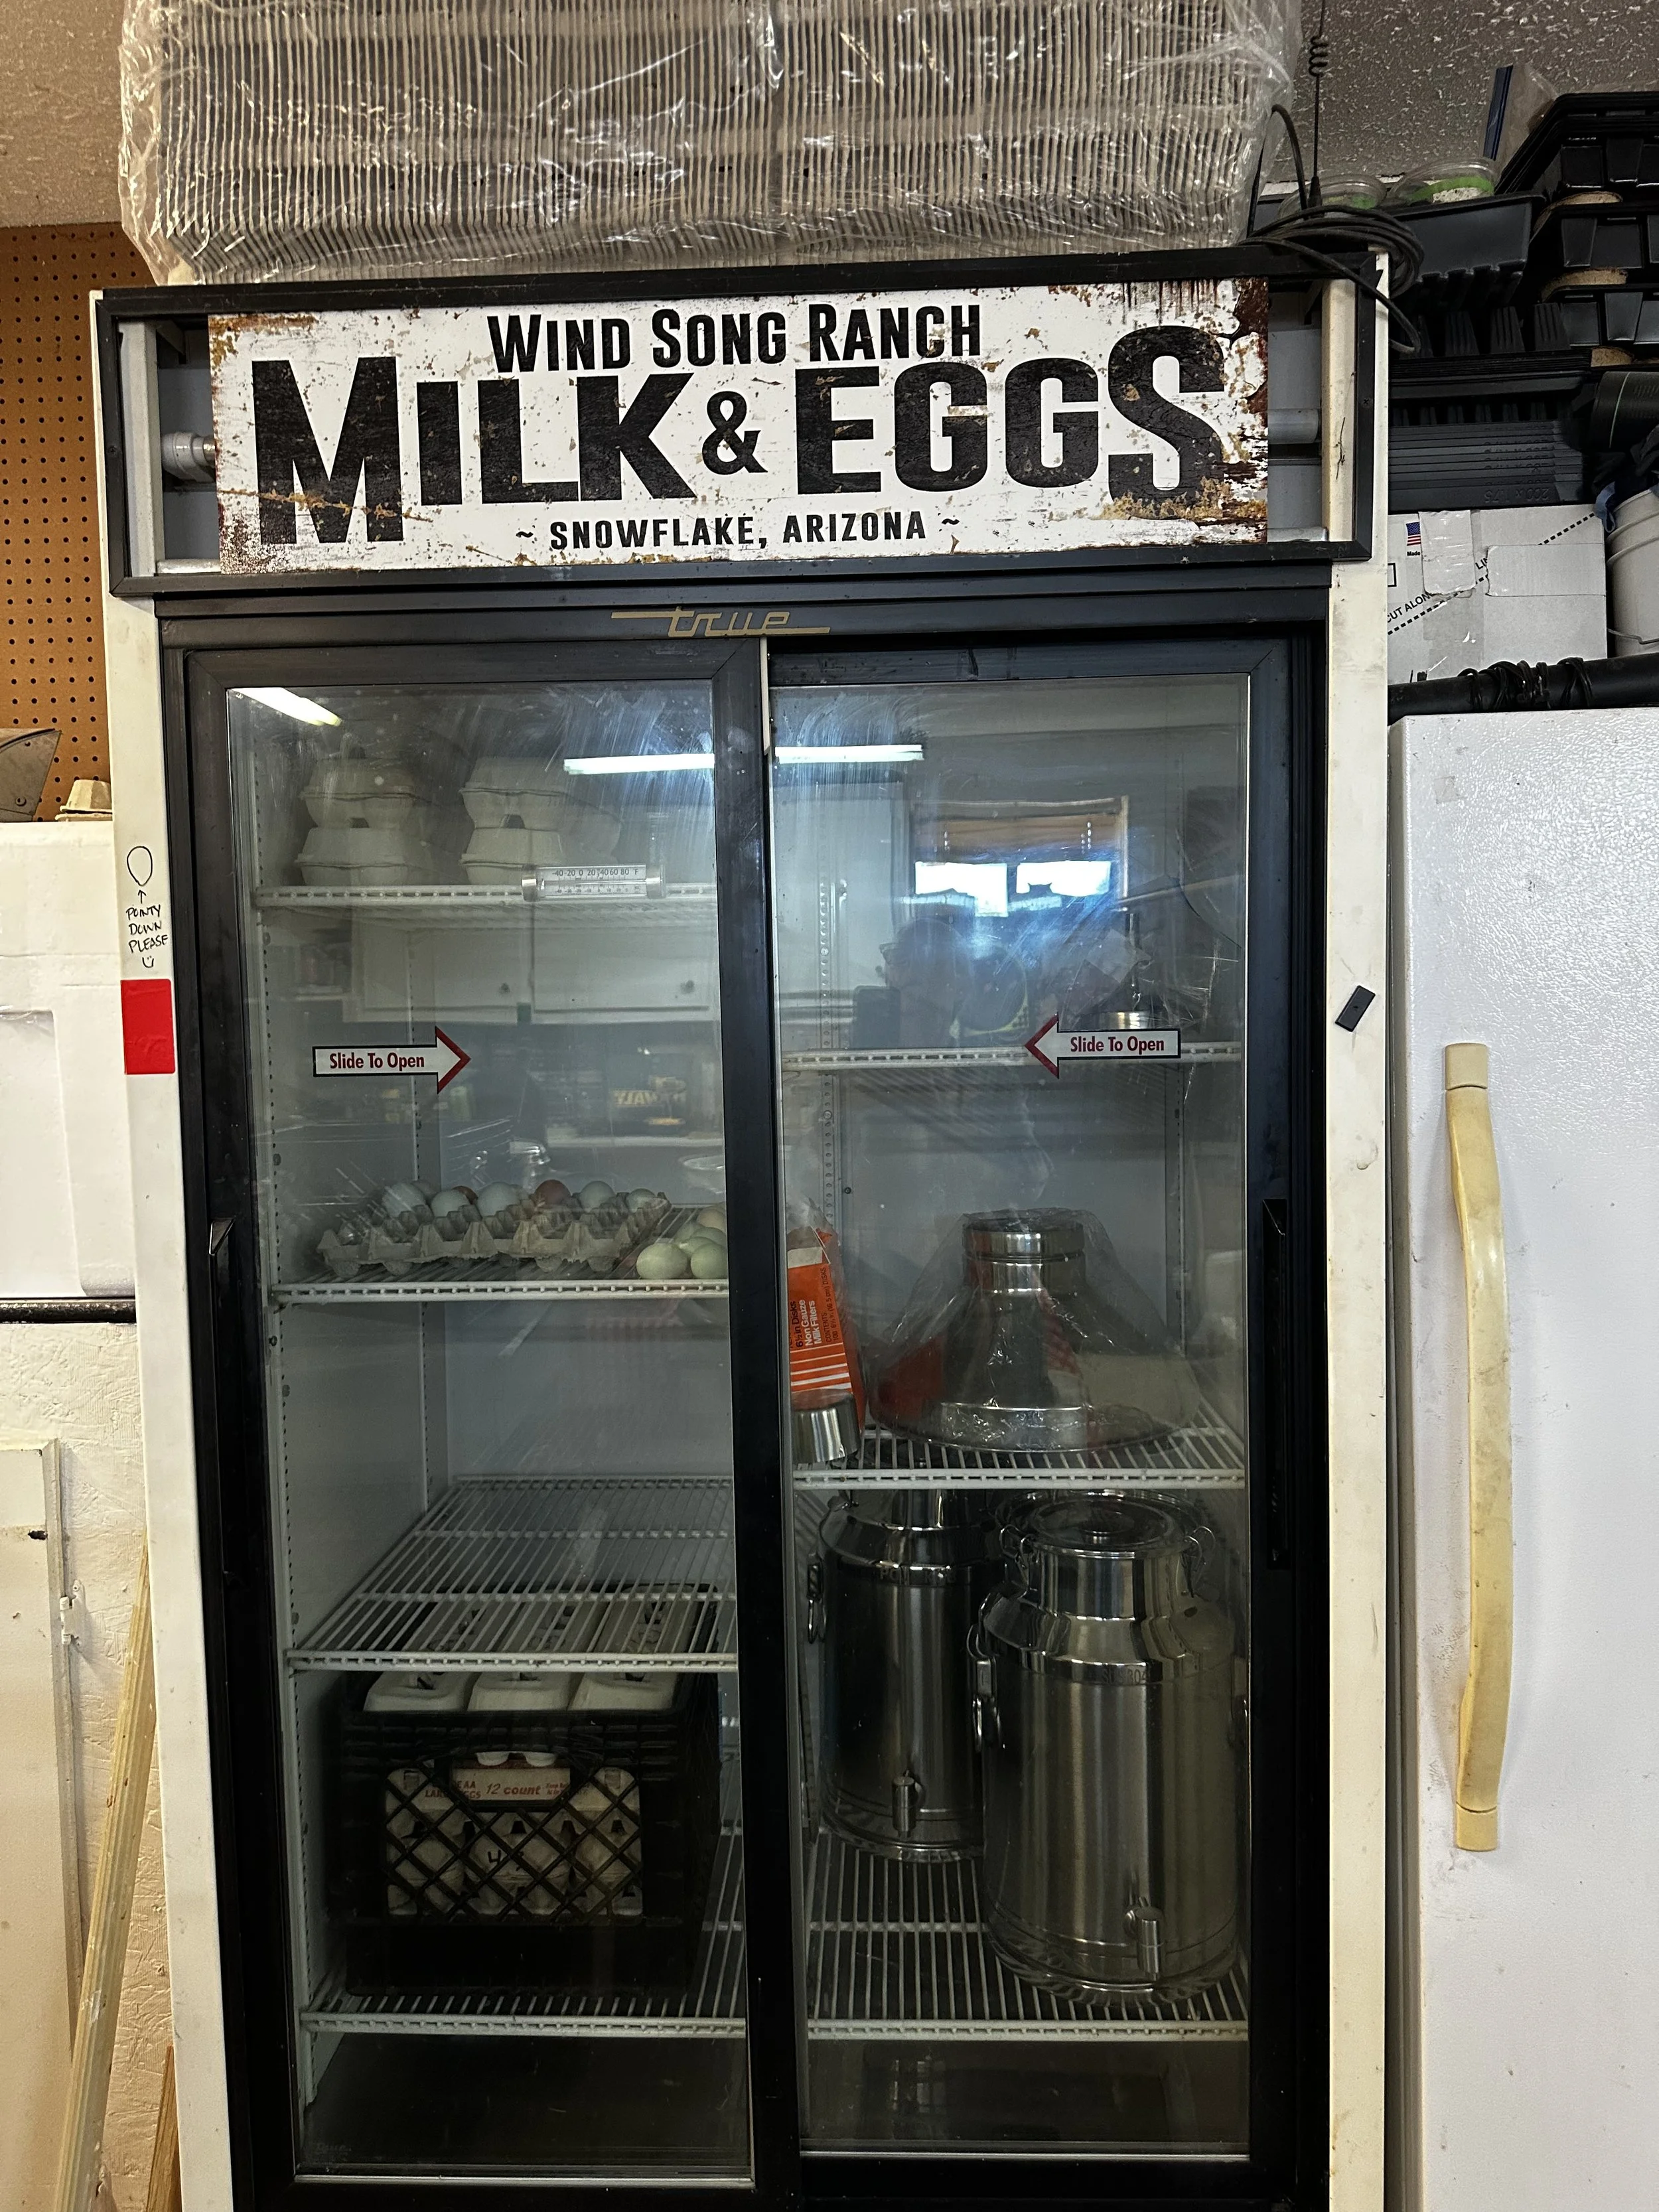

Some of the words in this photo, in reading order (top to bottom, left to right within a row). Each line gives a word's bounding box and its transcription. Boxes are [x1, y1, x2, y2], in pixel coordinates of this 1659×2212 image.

[486, 314, 630, 373] WIND
[652, 309, 786, 368] SONG
[808, 303, 981, 362] RANCH
[252, 356, 697, 544] MILK
[701, 390, 768, 475] &
[796, 325, 1226, 520] EGGS
[549, 515, 767, 551] SNOWFLAKE,
[782, 511, 926, 544] ARIZONA
[611, 606, 831, 638] true
[125, 904, 161, 920] POINTY
[128, 921, 162, 935] DOWN
[128, 934, 169, 953] PLEASE
[1070, 1035, 1104, 1053] Slide
[1108, 1036, 1123, 1052] To
[1127, 1035, 1165, 1055] Open
[329, 1052, 364, 1069] Slide
[368, 1053, 384, 1069] To
[387, 1052, 425, 1071] Open
[790, 1301, 800, 1325] Disks
[799, 1299, 810, 1327] Gauze
[809, 1300, 819, 1327] Filters
[804, 1327, 814, 1346] Non
[812, 1327, 822, 1345] Milk
[486, 1783, 501, 1795] 12
[504, 1786, 541, 1795] count
